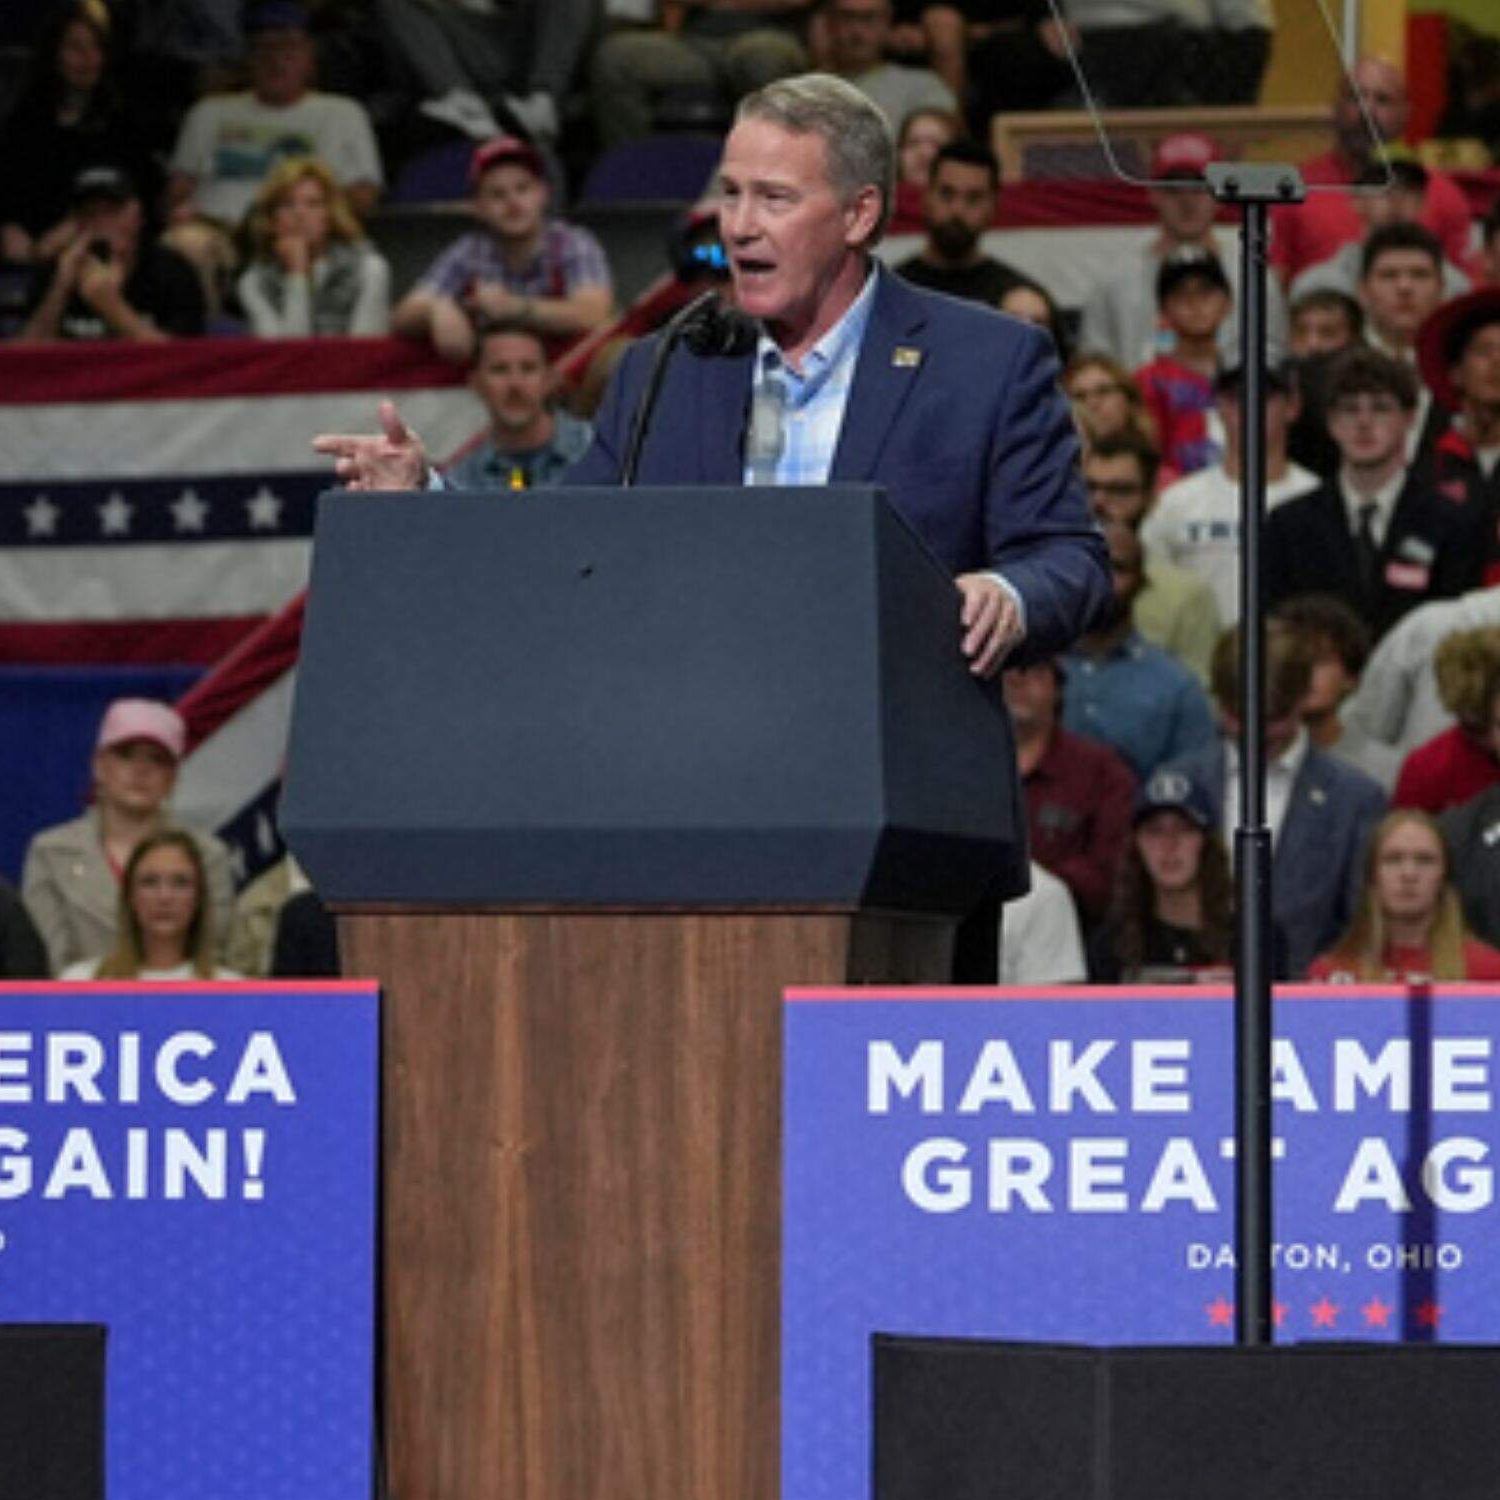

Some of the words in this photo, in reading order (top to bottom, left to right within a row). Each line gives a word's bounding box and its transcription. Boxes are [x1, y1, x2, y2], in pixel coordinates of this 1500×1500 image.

[868, 1040, 1191, 1113] MAKE
[1187, 1243, 1351, 1273] DATON,
[1366, 1243, 1463, 1271] OHIO
